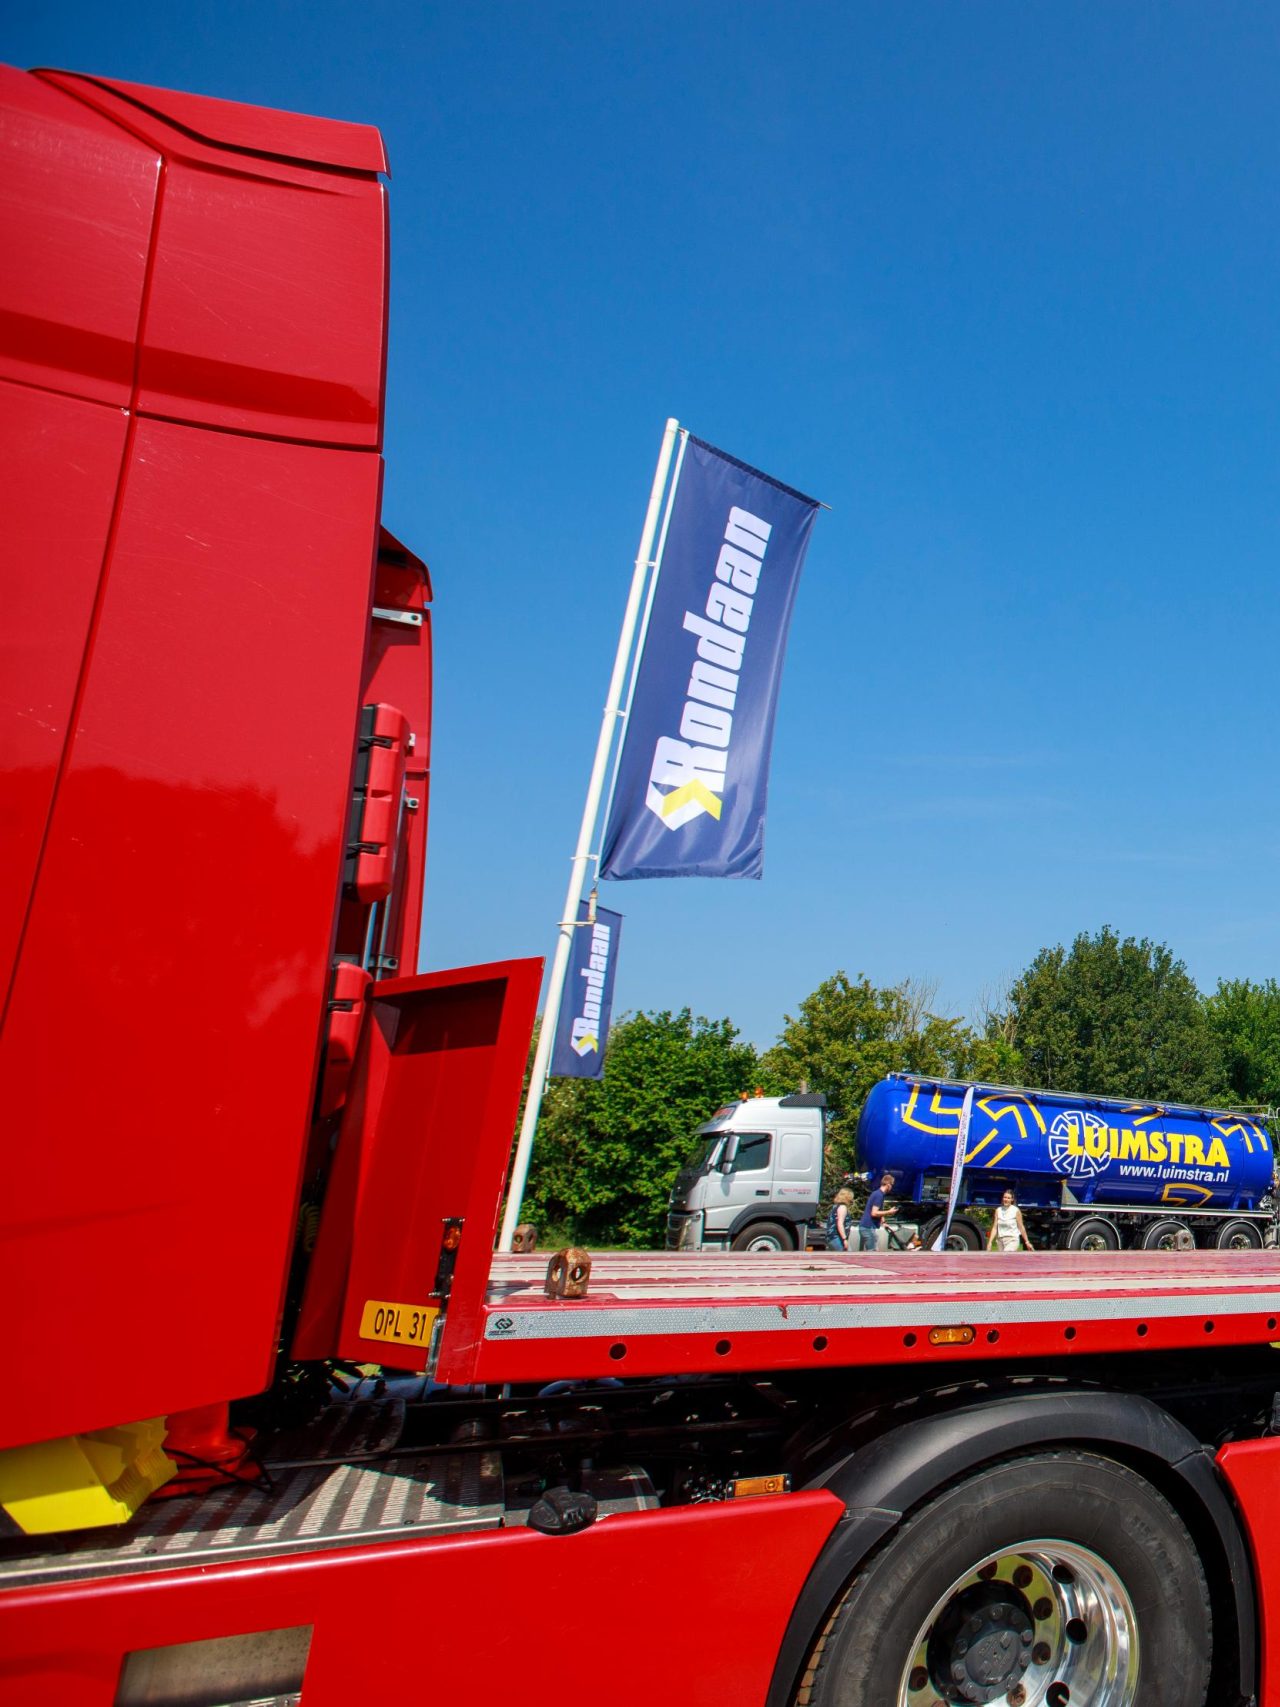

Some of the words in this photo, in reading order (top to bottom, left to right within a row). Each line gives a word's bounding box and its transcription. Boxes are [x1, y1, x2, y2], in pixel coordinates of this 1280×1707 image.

[651, 505, 772, 794] Rondaan
[571, 922, 610, 1041] Rondaan
[1067, 1125, 1231, 1167] LUIMSTRA
[1120, 1164, 1229, 1183] www.luimstra.nl
[374, 1308, 401, 1337] OPL
